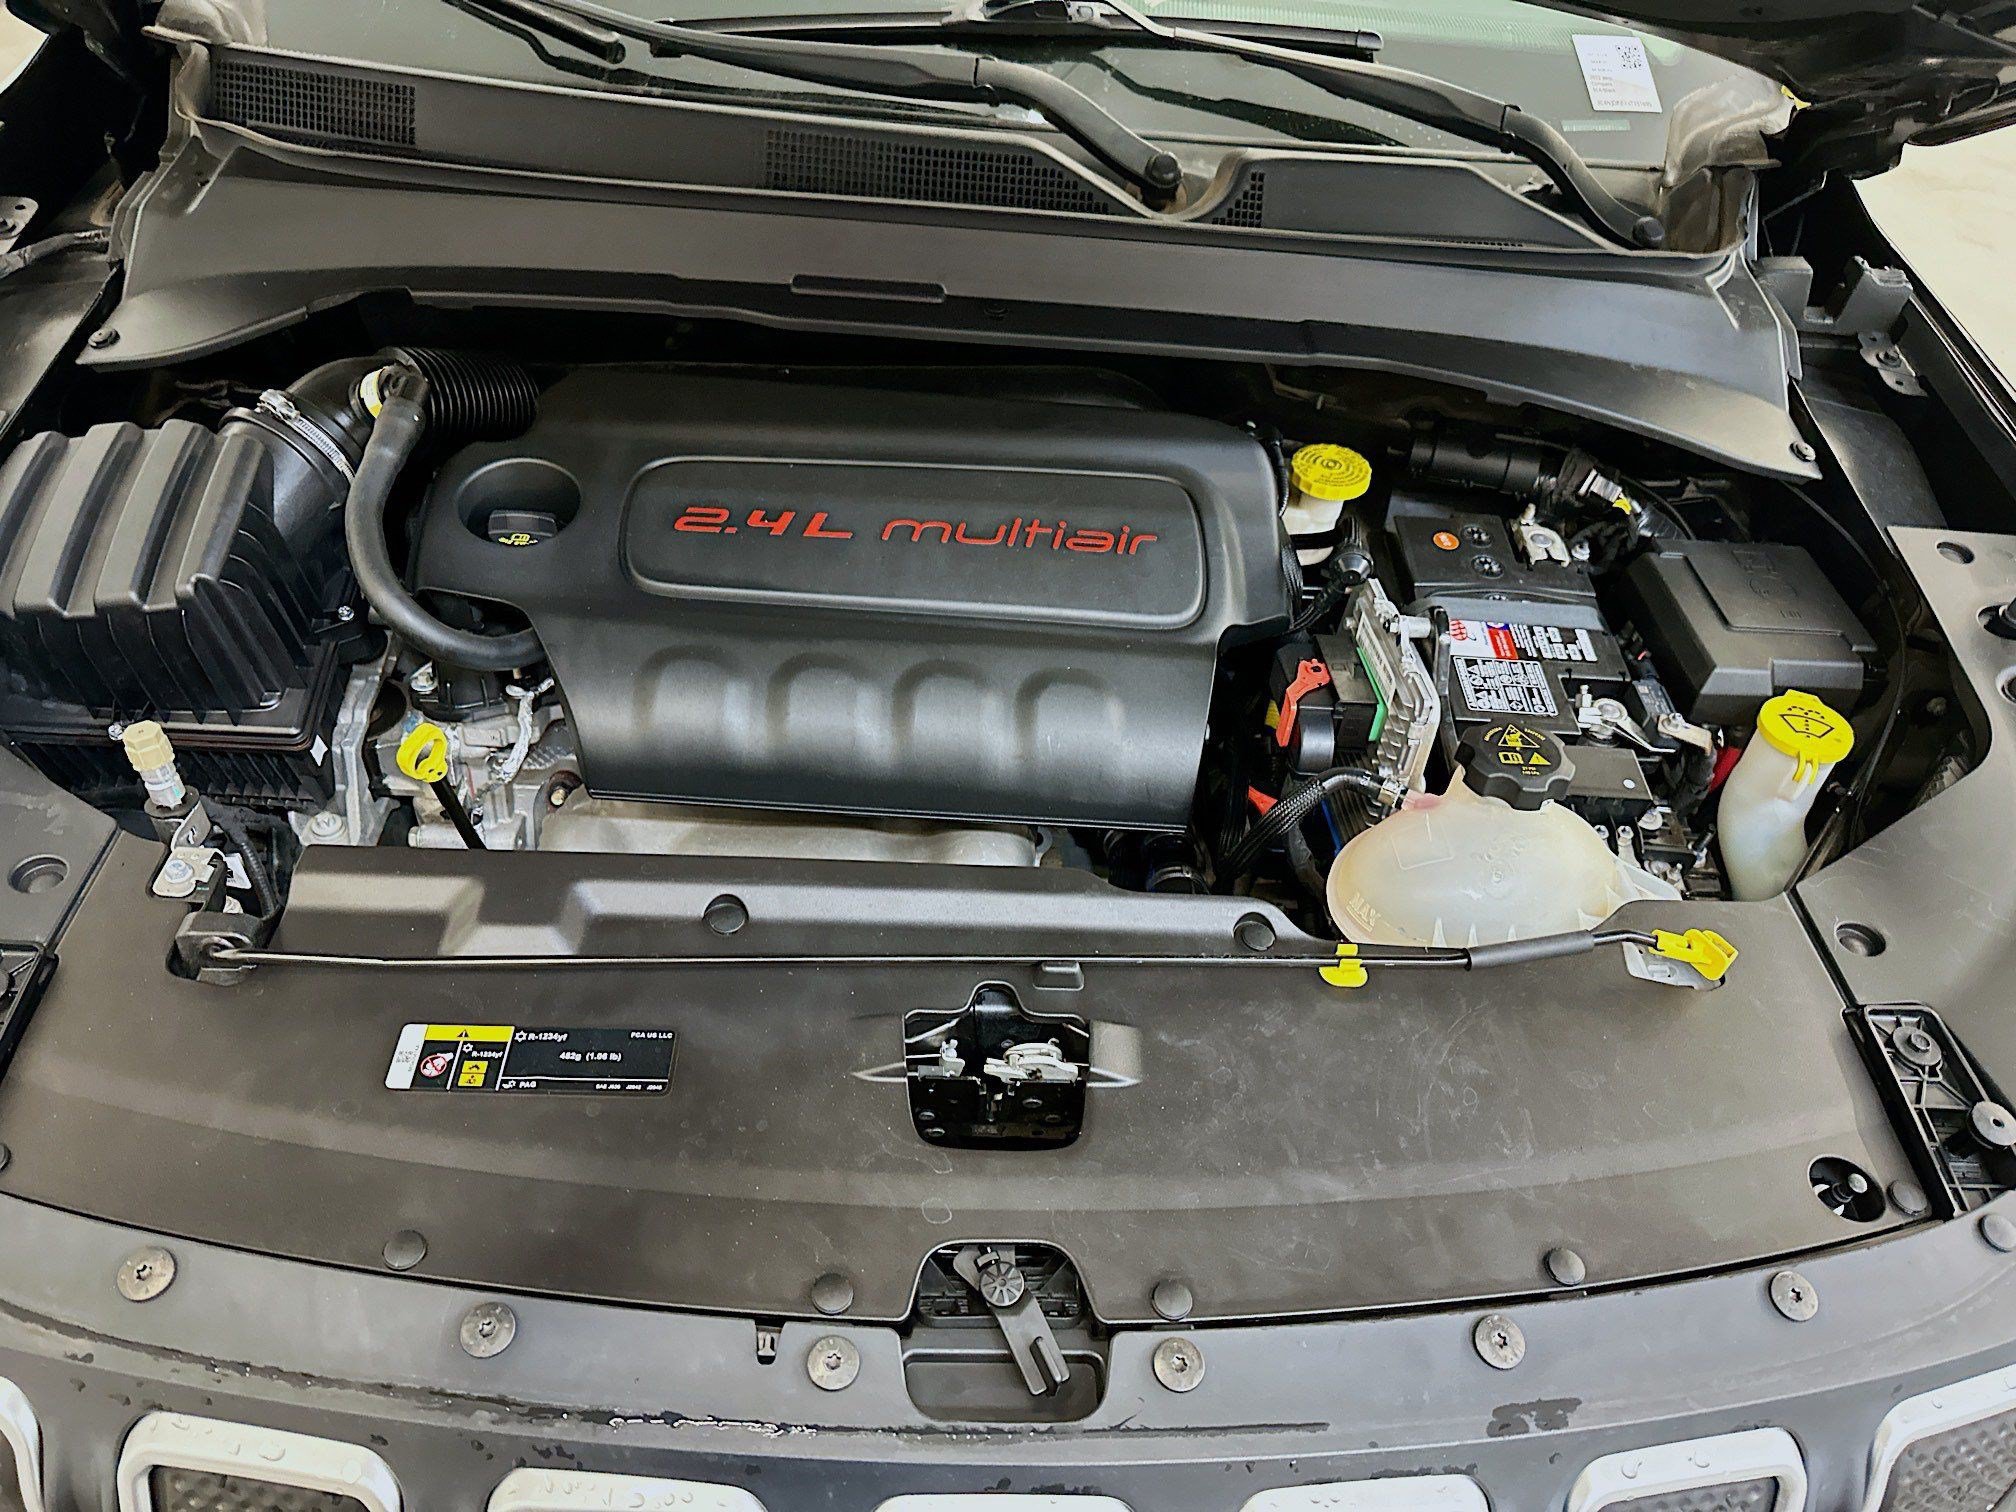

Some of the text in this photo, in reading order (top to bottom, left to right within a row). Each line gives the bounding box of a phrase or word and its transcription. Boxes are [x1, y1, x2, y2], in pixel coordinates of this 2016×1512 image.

[881, 516, 1158, 555] multiair
[527, 1032, 568, 1042] R-1234yf
[630, 1031, 646, 1039] FCA
[609, 1052, 622, 1062] lb)
